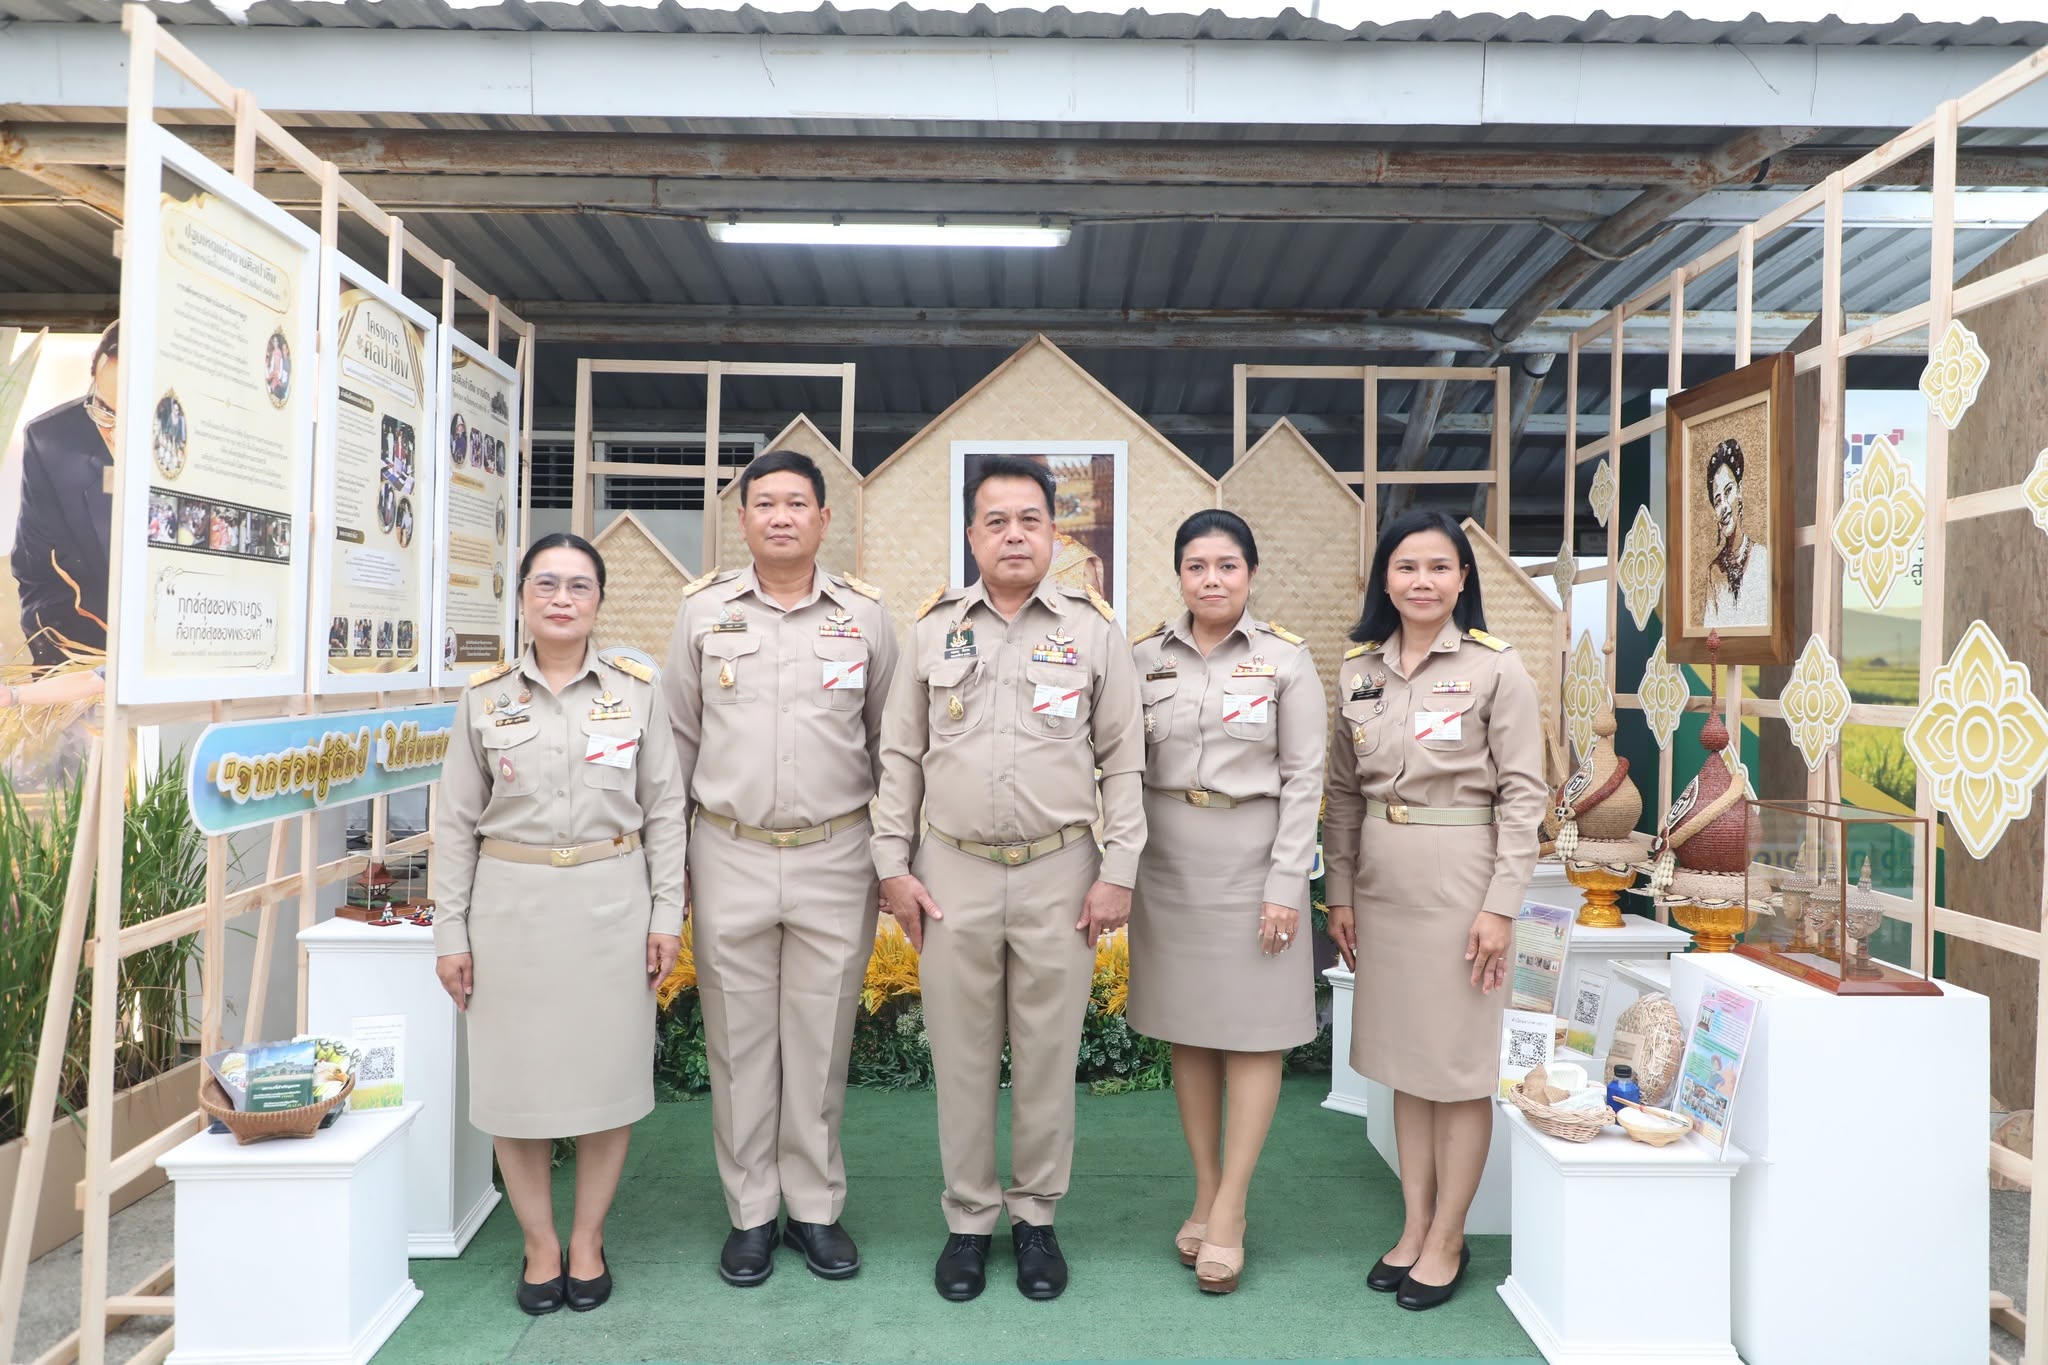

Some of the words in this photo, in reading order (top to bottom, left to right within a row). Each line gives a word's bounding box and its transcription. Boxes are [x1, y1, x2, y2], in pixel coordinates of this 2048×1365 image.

[366, 311, 399, 348] โครงการ
[364, 333, 409, 380] ศิลปาชีพ
